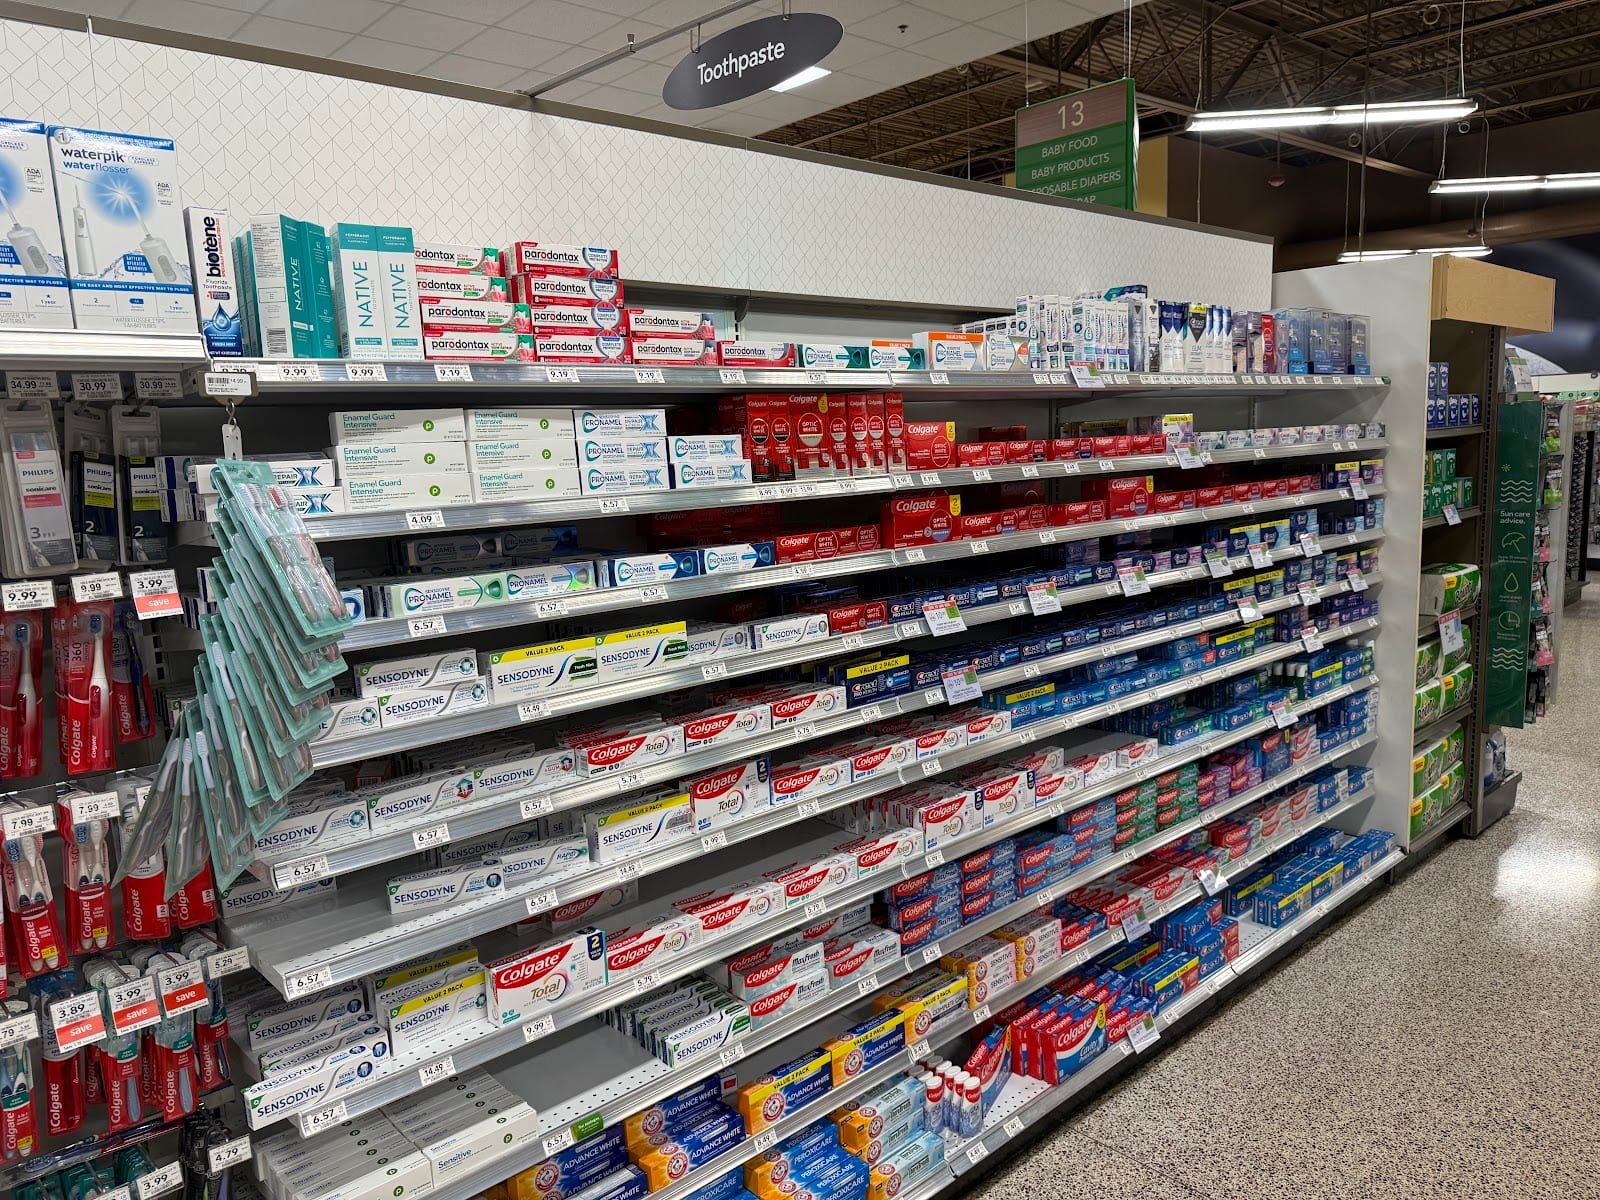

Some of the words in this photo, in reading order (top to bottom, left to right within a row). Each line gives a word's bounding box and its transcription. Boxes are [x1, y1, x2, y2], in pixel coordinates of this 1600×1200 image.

[697, 42, 785, 85] Toothpaste
[1058, 101, 1084, 129] 13
[1042, 144, 1066, 157] BABY
[1069, 136, 1098, 150] FOOD
[61, 148, 125, 162] waterpik
[64, 161, 129, 174] waterflosser
[1032, 165, 1055, 179] BABY
[1058, 153, 1109, 173] PRODUCTS
[1032, 180, 1077, 195] POSABLE
[1080, 170, 1120, 188] DIAPERS
[524, 250, 579, 263] parodontax
[290, 257, 302, 311] NATIVE
[534, 282, 586, 294] parodontax
[353, 261, 373, 327] NATIVE
[390, 263, 410, 329] NATIVE
[428, 306, 485, 318] parodontax
[634, 316, 679, 326] parodontax
[432, 338, 489, 350] parodontax
[539, 341, 592, 353] parodontax
[284, 368, 307, 376] 9.99
[440, 369, 460, 377] 9.19
[11, 381, 37, 389] 34.99
[79, 382, 106, 390] 30.99
[343, 413, 368, 422] Enamel
[371, 413, 395, 421] Guard
[343, 420, 377, 428] Intensive
[908, 424, 938, 434] Colgate
[344, 447, 369, 455] Enamel
[372, 446, 396, 454] Guard
[344, 453, 378, 462] Intensive
[87, 468, 112, 477] PHILIPS
[480, 473, 502, 481] Enamel
[504, 472, 523, 480] Guard
[349, 480, 375, 488] Enamel
[378, 479, 402, 487] Guard
[350, 487, 384, 495] Intensive
[480, 479, 508, 487] Intensive
[896, 500, 936, 512] Colgate
[412, 514, 432, 524] 4.09
[780, 537, 809, 546] Colgate
[137, 580, 163, 589] 3.99
[509, 578, 548, 589] PRONAMEL
[8, 591, 37, 601] 9.99
[149, 597, 169, 607] save
[408, 591, 454, 603] PRONAMEL
[832, 608, 859, 618] Colgate
[414, 621, 434, 631] 6.57
[765, 628, 801, 641] SENSODYNE
[72, 642, 82, 662] 360
[526, 648, 542, 657] VALUE
[551, 644, 564, 652] PACK
[601, 648, 650, 664] SENSODYNE
[366, 668, 430, 686] SENSODYNE
[498, 666, 554, 684] SENSODYNE
[705, 666, 719, 674] 6.57
[385, 696, 444, 715] SENSODYNE
[776, 697, 811, 714] Colgate
[121, 694, 131, 735] Colgate
[687, 718, 730, 735] Colgate
[71, 720, 83, 765] Colgate
[645, 740, 665, 752] Total
[591, 741, 640, 762] Colgate
[856, 752, 887, 767] Colgate
[479, 768, 534, 788] SENSODYNE
[621, 774, 637, 783] 5.79
[696, 773, 740, 794] Colgate
[775, 772, 814, 792] Colgate
[818, 772, 835, 784] Total
[984, 780, 1013, 796] Colgate
[79, 804, 99, 814] 7.99
[374, 794, 432, 818] SENSODYNE
[718, 796, 739, 812] Total
[928, 800, 961, 820] Colgate
[12, 819, 33, 830] 7.99
[603, 823, 653, 845] SENSODYNE
[859, 848, 892, 866] Colgate
[294, 864, 316, 876] 6.57
[788, 875, 824, 894] Colgate
[394, 884, 456, 904] SENSODYNE
[529, 895, 548, 906] 6.57
[131, 889, 143, 931] Colgate
[702, 905, 744, 926] Colgate
[749, 902, 767, 915] Total
[904, 902, 931, 919] Colgate
[82, 901, 90, 938] Colgate
[30, 922, 40, 959] Colgate
[1038, 926, 1059, 942] SENSITIVE
[1063, 926, 1093, 947] Colgate
[591, 936, 600, 949] 2
[611, 944, 656, 966] Colgate
[991, 952, 1013, 967] SENSITIVE
[500, 953, 560, 984] Colgate
[835, 956, 868, 973] Colgate
[165, 972, 189, 986] 3.99
[297, 974, 319, 987] 6.57
[747, 962, 785, 984] Colgate
[116, 989, 141, 1002] 3.99
[176, 990, 196, 1002] save
[423, 992, 440, 1003] VALUE
[448, 983, 464, 993] PACK
[530, 980, 560, 1000] Total
[753, 991, 791, 1012] Colgate
[933, 999, 954, 1015] COMPLETE
[59, 1004, 85, 1019] 3.89
[126, 1007, 147, 1019] save
[394, 1003, 450, 1032] SENSODYNE
[69, 1023, 92, 1036] save
[255, 1014, 317, 1040] SENSODYNE
[1046, 1016, 1072, 1034] Colgate
[1058, 1018, 1092, 1046] Colgate
[676, 1032, 723, 1060] SENSODYNE
[865, 1043, 888, 1059] ADVANCE
[887, 1034, 903, 1047] WHITE
[967, 1044, 987, 1068] Colgate
[424, 1064, 443, 1077] 14.49
[773, 1078, 790, 1090] VALUE
[795, 1066, 809, 1077] PACK
[166, 1071, 175, 1113] Colgate
[787, 1083, 811, 1102] ADVANCE
[812, 1074, 830, 1088] WHITE
[51, 1084, 61, 1127] Colgate
[111, 1080, 120, 1124] Colgate
[257, 1082, 325, 1117] SENSODYNE
[667, 1096, 698, 1116] ADVANCE
[699, 1087, 718, 1100] WHITE
[312, 1109, 334, 1124] 6.57
[7, 1113, 16, 1149] Colgate
[691, 1140, 722, 1159] ADVANCE
[719, 1126, 741, 1143] WHITE
[795, 1136, 832, 1164] PEROXICARE
[216, 1149, 238, 1161] 4.79
[438, 1150, 472, 1169] Sensitive
[564, 1149, 597, 1170] ADVANCE
[597, 1136, 620, 1153] WHITE
